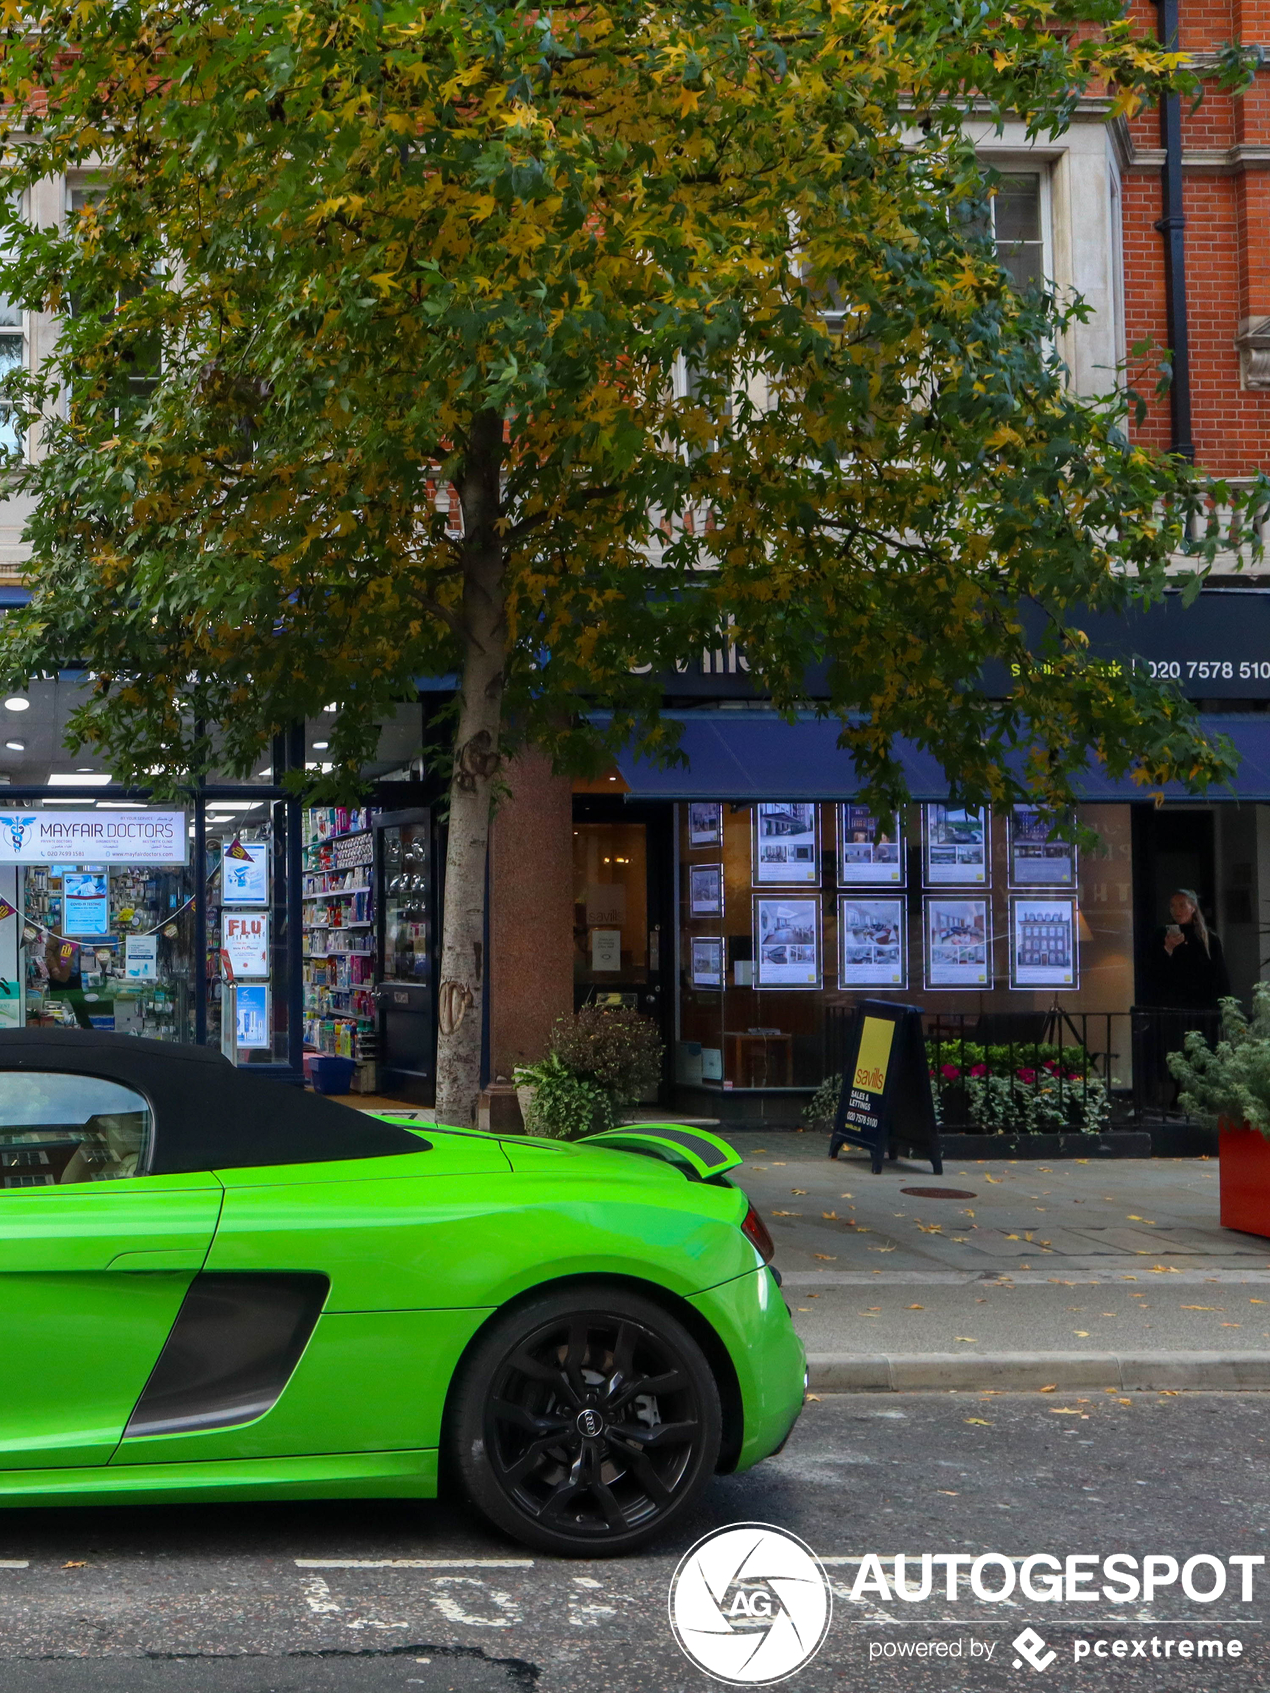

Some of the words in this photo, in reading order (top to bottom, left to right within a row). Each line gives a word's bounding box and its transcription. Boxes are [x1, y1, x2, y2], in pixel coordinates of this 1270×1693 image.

[1186, 661, 1234, 679] 7578
[40, 823, 104, 838] MAYFAIR
[107, 823, 174, 838] DOCTORS
[228, 919, 262, 936] FLU
[856, 1068, 884, 1089] savills
[851, 1090, 865, 1101] SALES
[849, 1098, 871, 1111] LETTINGS
[847, 1111, 855, 1120] 020
[856, 1113, 867, 1123] 7578
[866, 1117, 878, 1128] 5100
